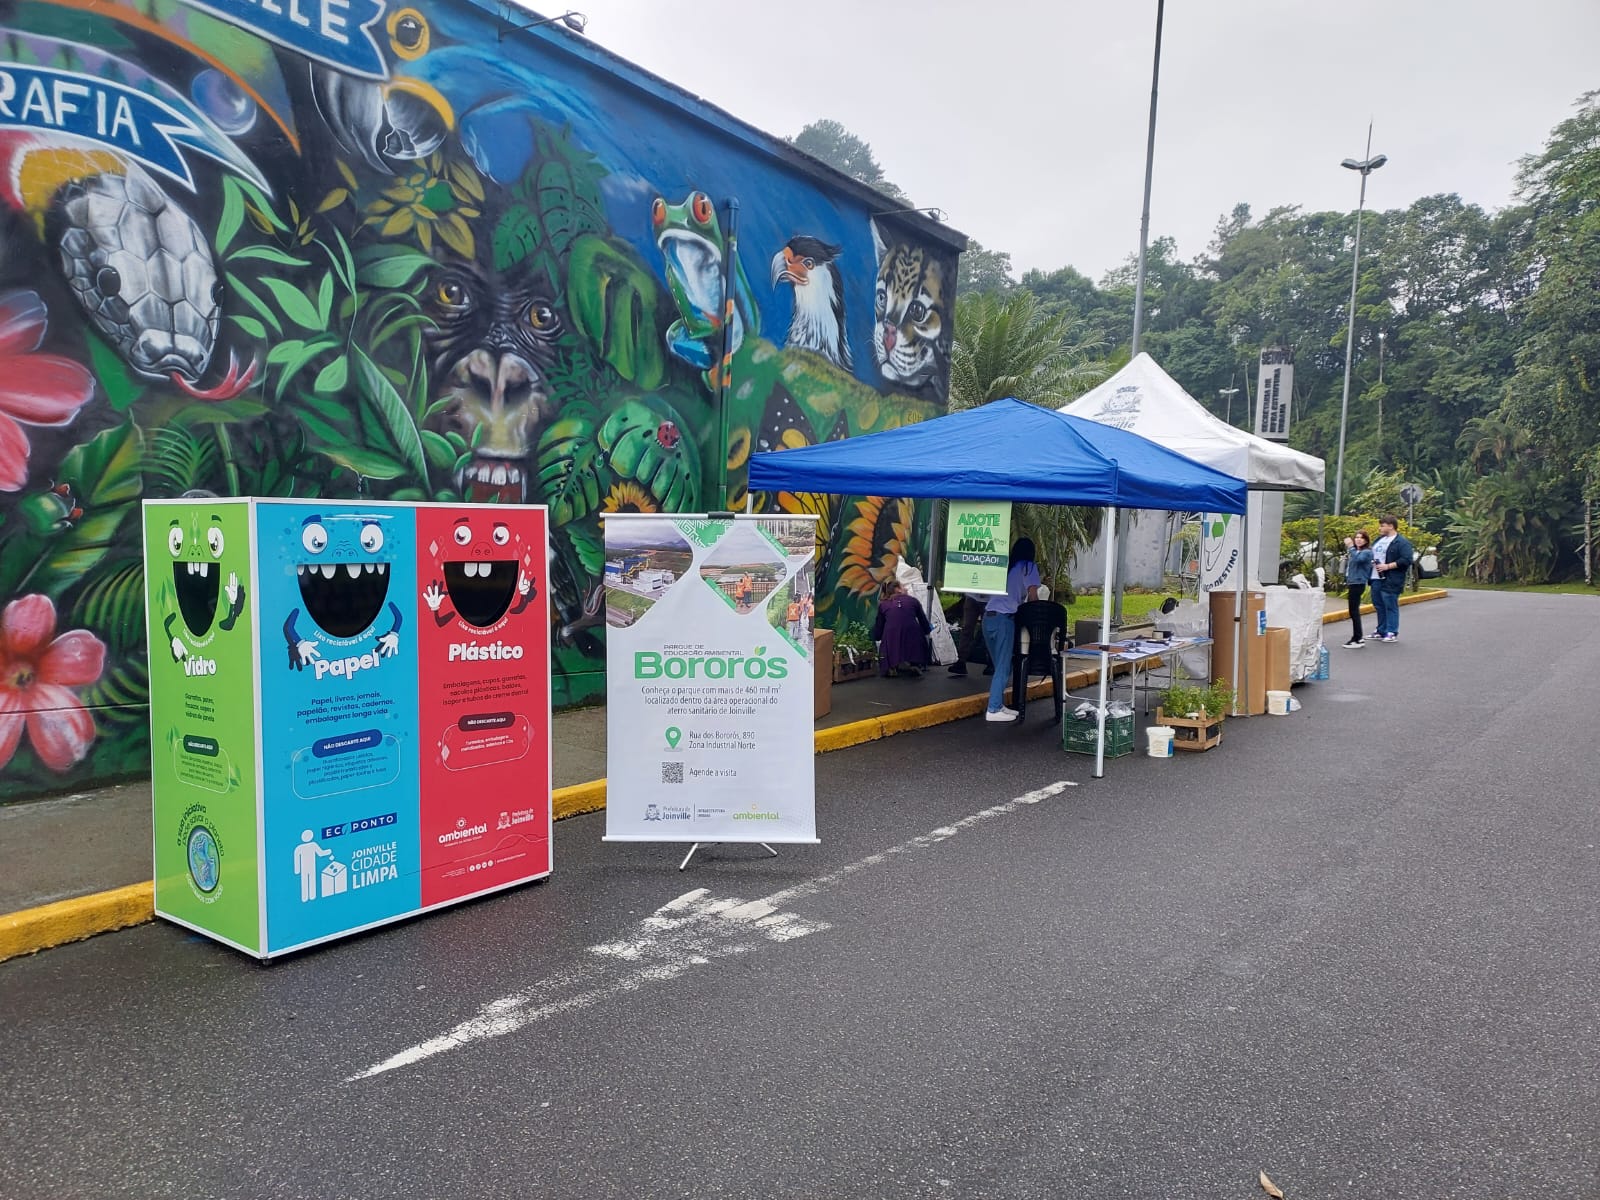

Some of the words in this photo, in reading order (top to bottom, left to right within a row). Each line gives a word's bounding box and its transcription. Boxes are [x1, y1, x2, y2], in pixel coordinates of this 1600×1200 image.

[957, 513, 1001, 527] ADOTE
[963, 526, 993, 539] UMA
[958, 539, 996, 553] MUDA
[1214, 548, 1239, 587] DESTINO
[313, 630, 326, 642] Lixo
[326, 637, 358, 647] reciclável
[362, 626, 376, 640] aqui
[448, 640, 524, 662] Plástico
[184, 655, 217, 677] Vidro
[314, 648, 380, 681] Papel
[634, 646, 788, 679] Bororós
[443, 679, 481, 689] Embalagens,
[641, 685, 670, 696] Conheça
[677, 687, 701, 696] parque
[718, 686, 734, 694] mais
[735, 685, 744, 694] de
[745, 686, 758, 694] 460
[759, 686, 770, 694] mil
[311, 696, 335, 706] Papel,
[334, 695, 357, 704] livros,
[356, 691, 382, 703] jornais,
[443, 697, 461, 706] isopor
[492, 692, 510, 700] creme
[644, 696, 679, 704] localizado
[679, 696, 702, 704] dentro
[703, 696, 712, 704] da
[713, 696, 728, 704] área
[729, 696, 768, 706] operacional
[769, 696, 778, 704] do
[296, 707, 330, 718] papelão,
[330, 703, 361, 713] revistas,
[361, 699, 395, 709] cadernos,
[667, 707, 687, 715] aterro
[688, 706, 717, 715] sanitário
[718, 706, 728, 715] de
[729, 706, 756, 715] Joinville
[305, 714, 351, 725] embalagens
[351, 710, 373, 721] longa
[373, 707, 388, 717] vida
[324, 742, 335, 750] NÃO
[335, 739, 359, 748] DESCARTE
[359, 736, 372, 745] AQUI
[689, 731, 701, 739] Rua
[702, 731, 714, 739] dos
[715, 731, 741, 741] Bororós,
[688, 741, 705, 749] Zona
[706, 740, 737, 749] Industrial
[737, 741, 756, 750] Norte
[689, 768, 714, 777] Agende
[719, 769, 737, 777] visita
[511, 813, 534, 825] Joinville
[662, 811, 691, 820] Joinville
[732, 811, 780, 820] ambiental
[438, 822, 488, 844] ambiental
[351, 841, 397, 859] JOINVILLE
[351, 850, 397, 872] CIDADE
[352, 863, 398, 890] LIMPA
